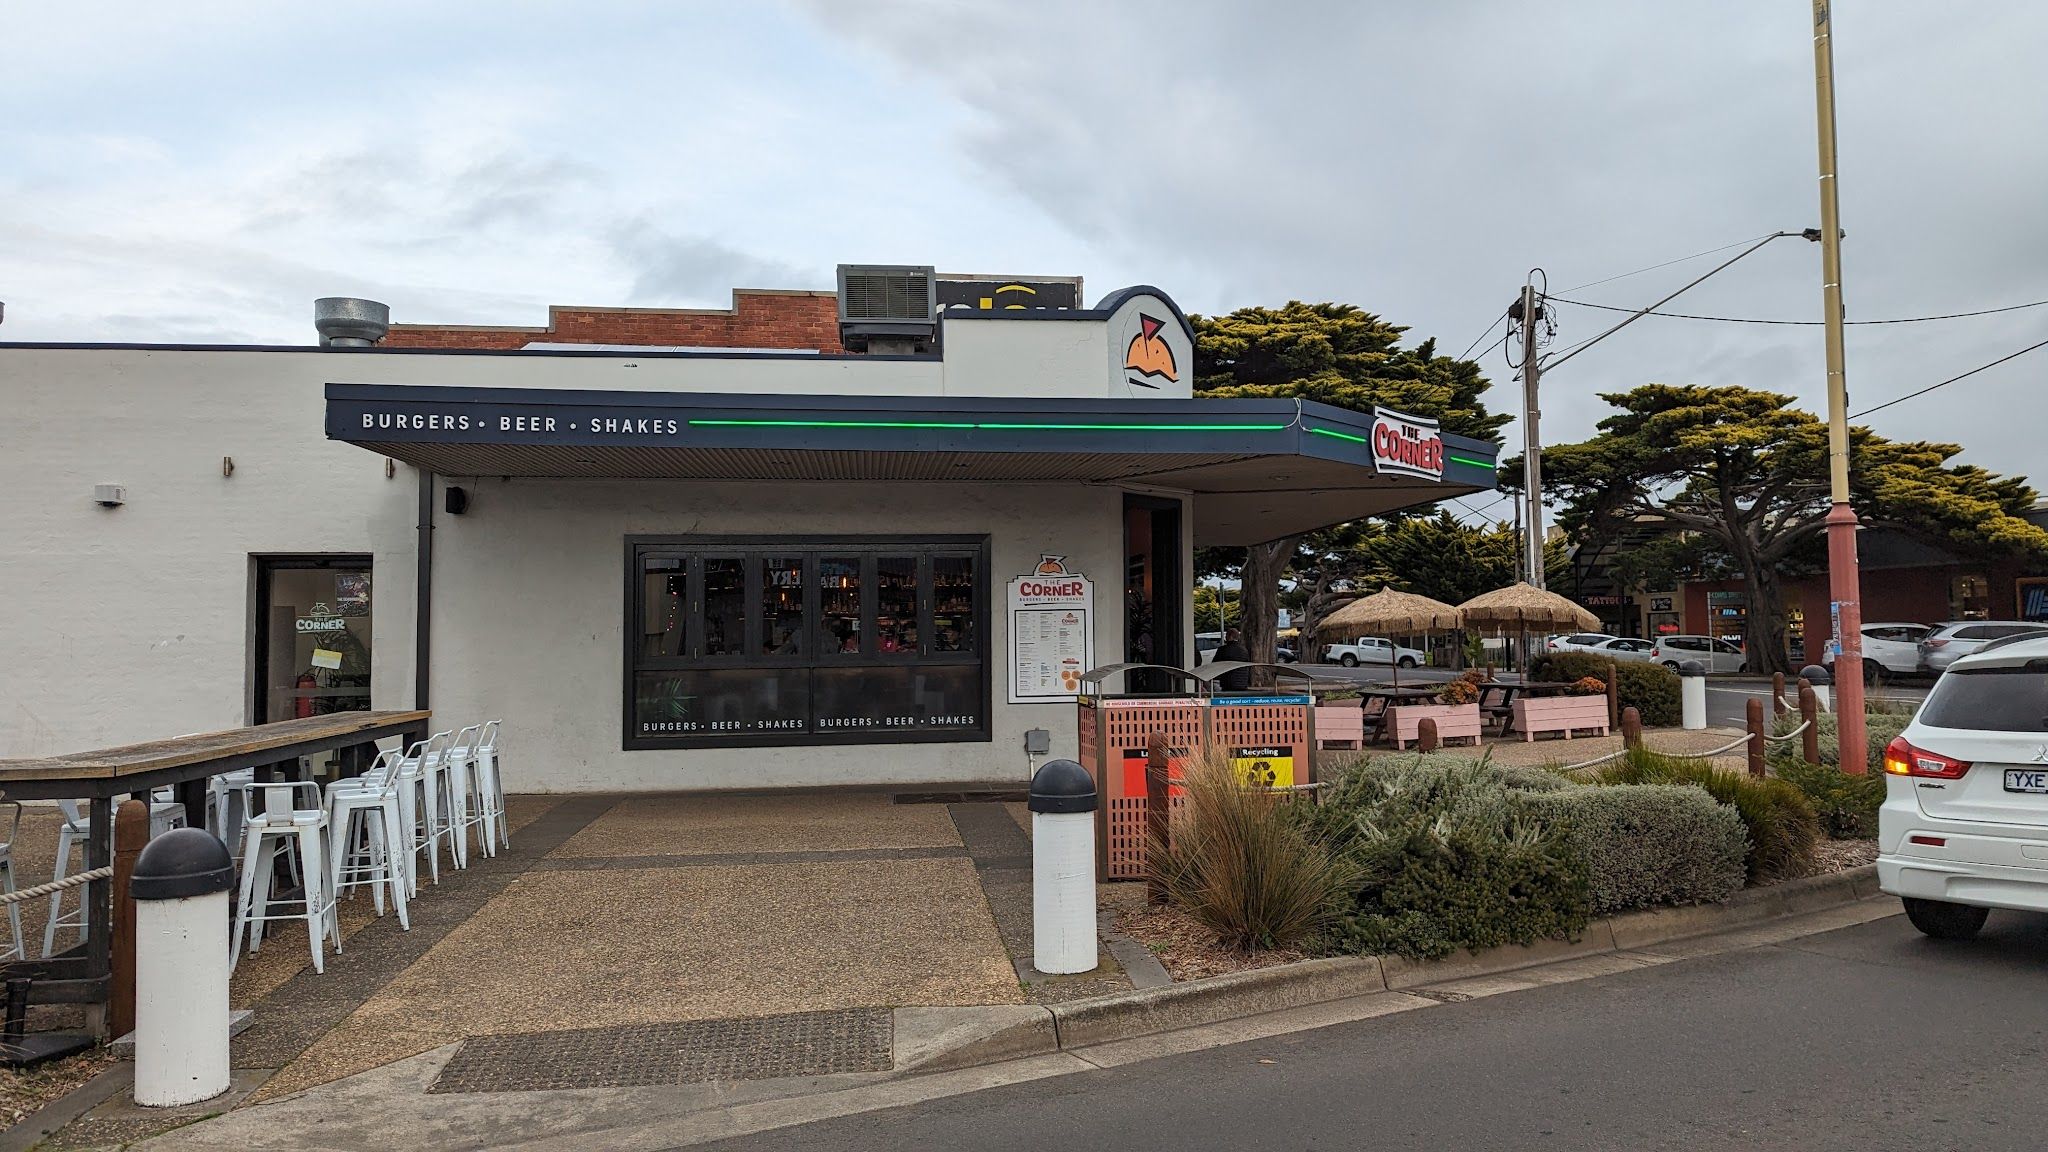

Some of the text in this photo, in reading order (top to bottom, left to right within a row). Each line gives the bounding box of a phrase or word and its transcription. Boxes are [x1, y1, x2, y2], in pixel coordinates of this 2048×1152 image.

[362, 413, 678, 434] BURGERS BEER SHAKES
[1402, 425, 1420, 440] THE
[1375, 422, 1444, 473] CORNER
[1020, 582, 1084, 596] CORNER
[296, 619, 346, 630] CORNER
[643, 720, 803, 731] BURGERS BEER SHAKES
[820, 716, 974, 727] BURGERS BEER SHAKES
[1242, 748, 1279, 757] Recycling
[2014, 773, 2046, 788] YXE
